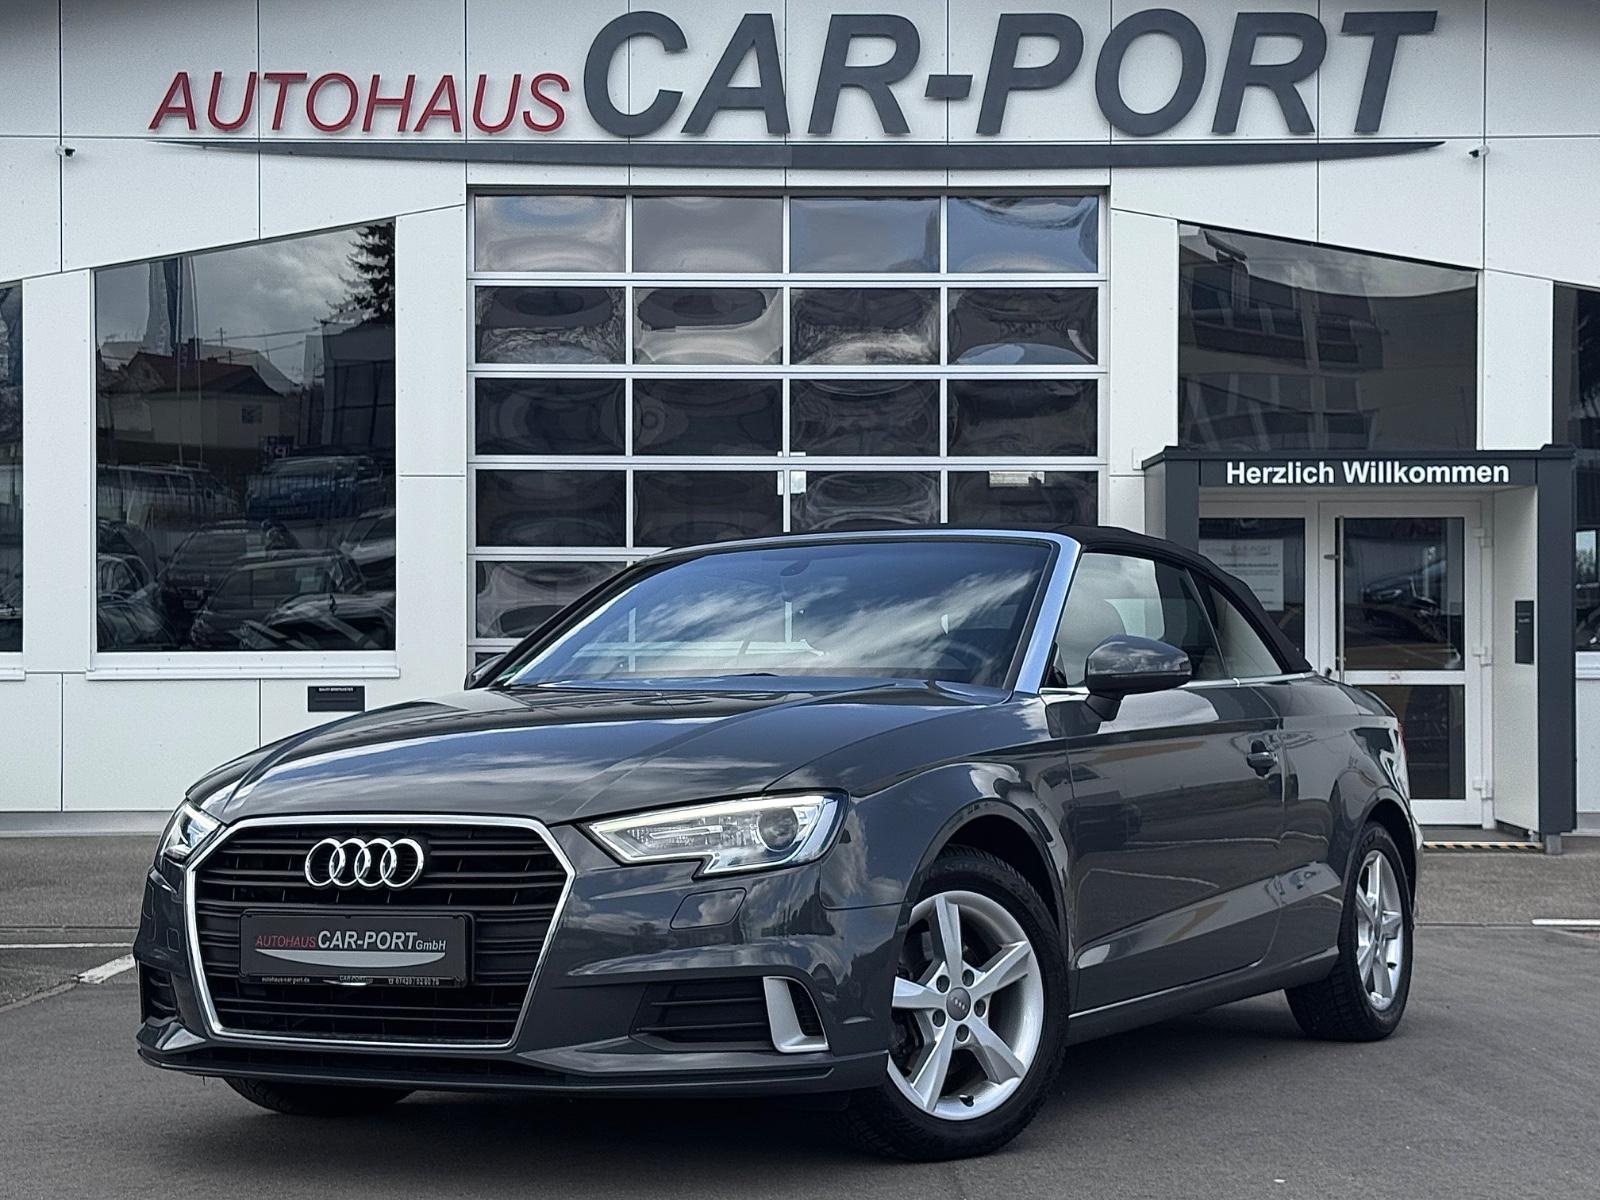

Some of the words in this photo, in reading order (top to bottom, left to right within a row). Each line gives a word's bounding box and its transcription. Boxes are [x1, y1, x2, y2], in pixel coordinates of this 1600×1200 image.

[148, 71, 570, 134] AUTOHAUS
[582, 8, 1438, 138] CAR-PORT
[1226, 461, 1335, 484] Herzlich
[1343, 461, 1510, 484] Willkommen
[256, 935, 316, 948] AUTOHAUS
[317, 930, 418, 950] CAR-PORT
[415, 939, 447, 951] GmbH
